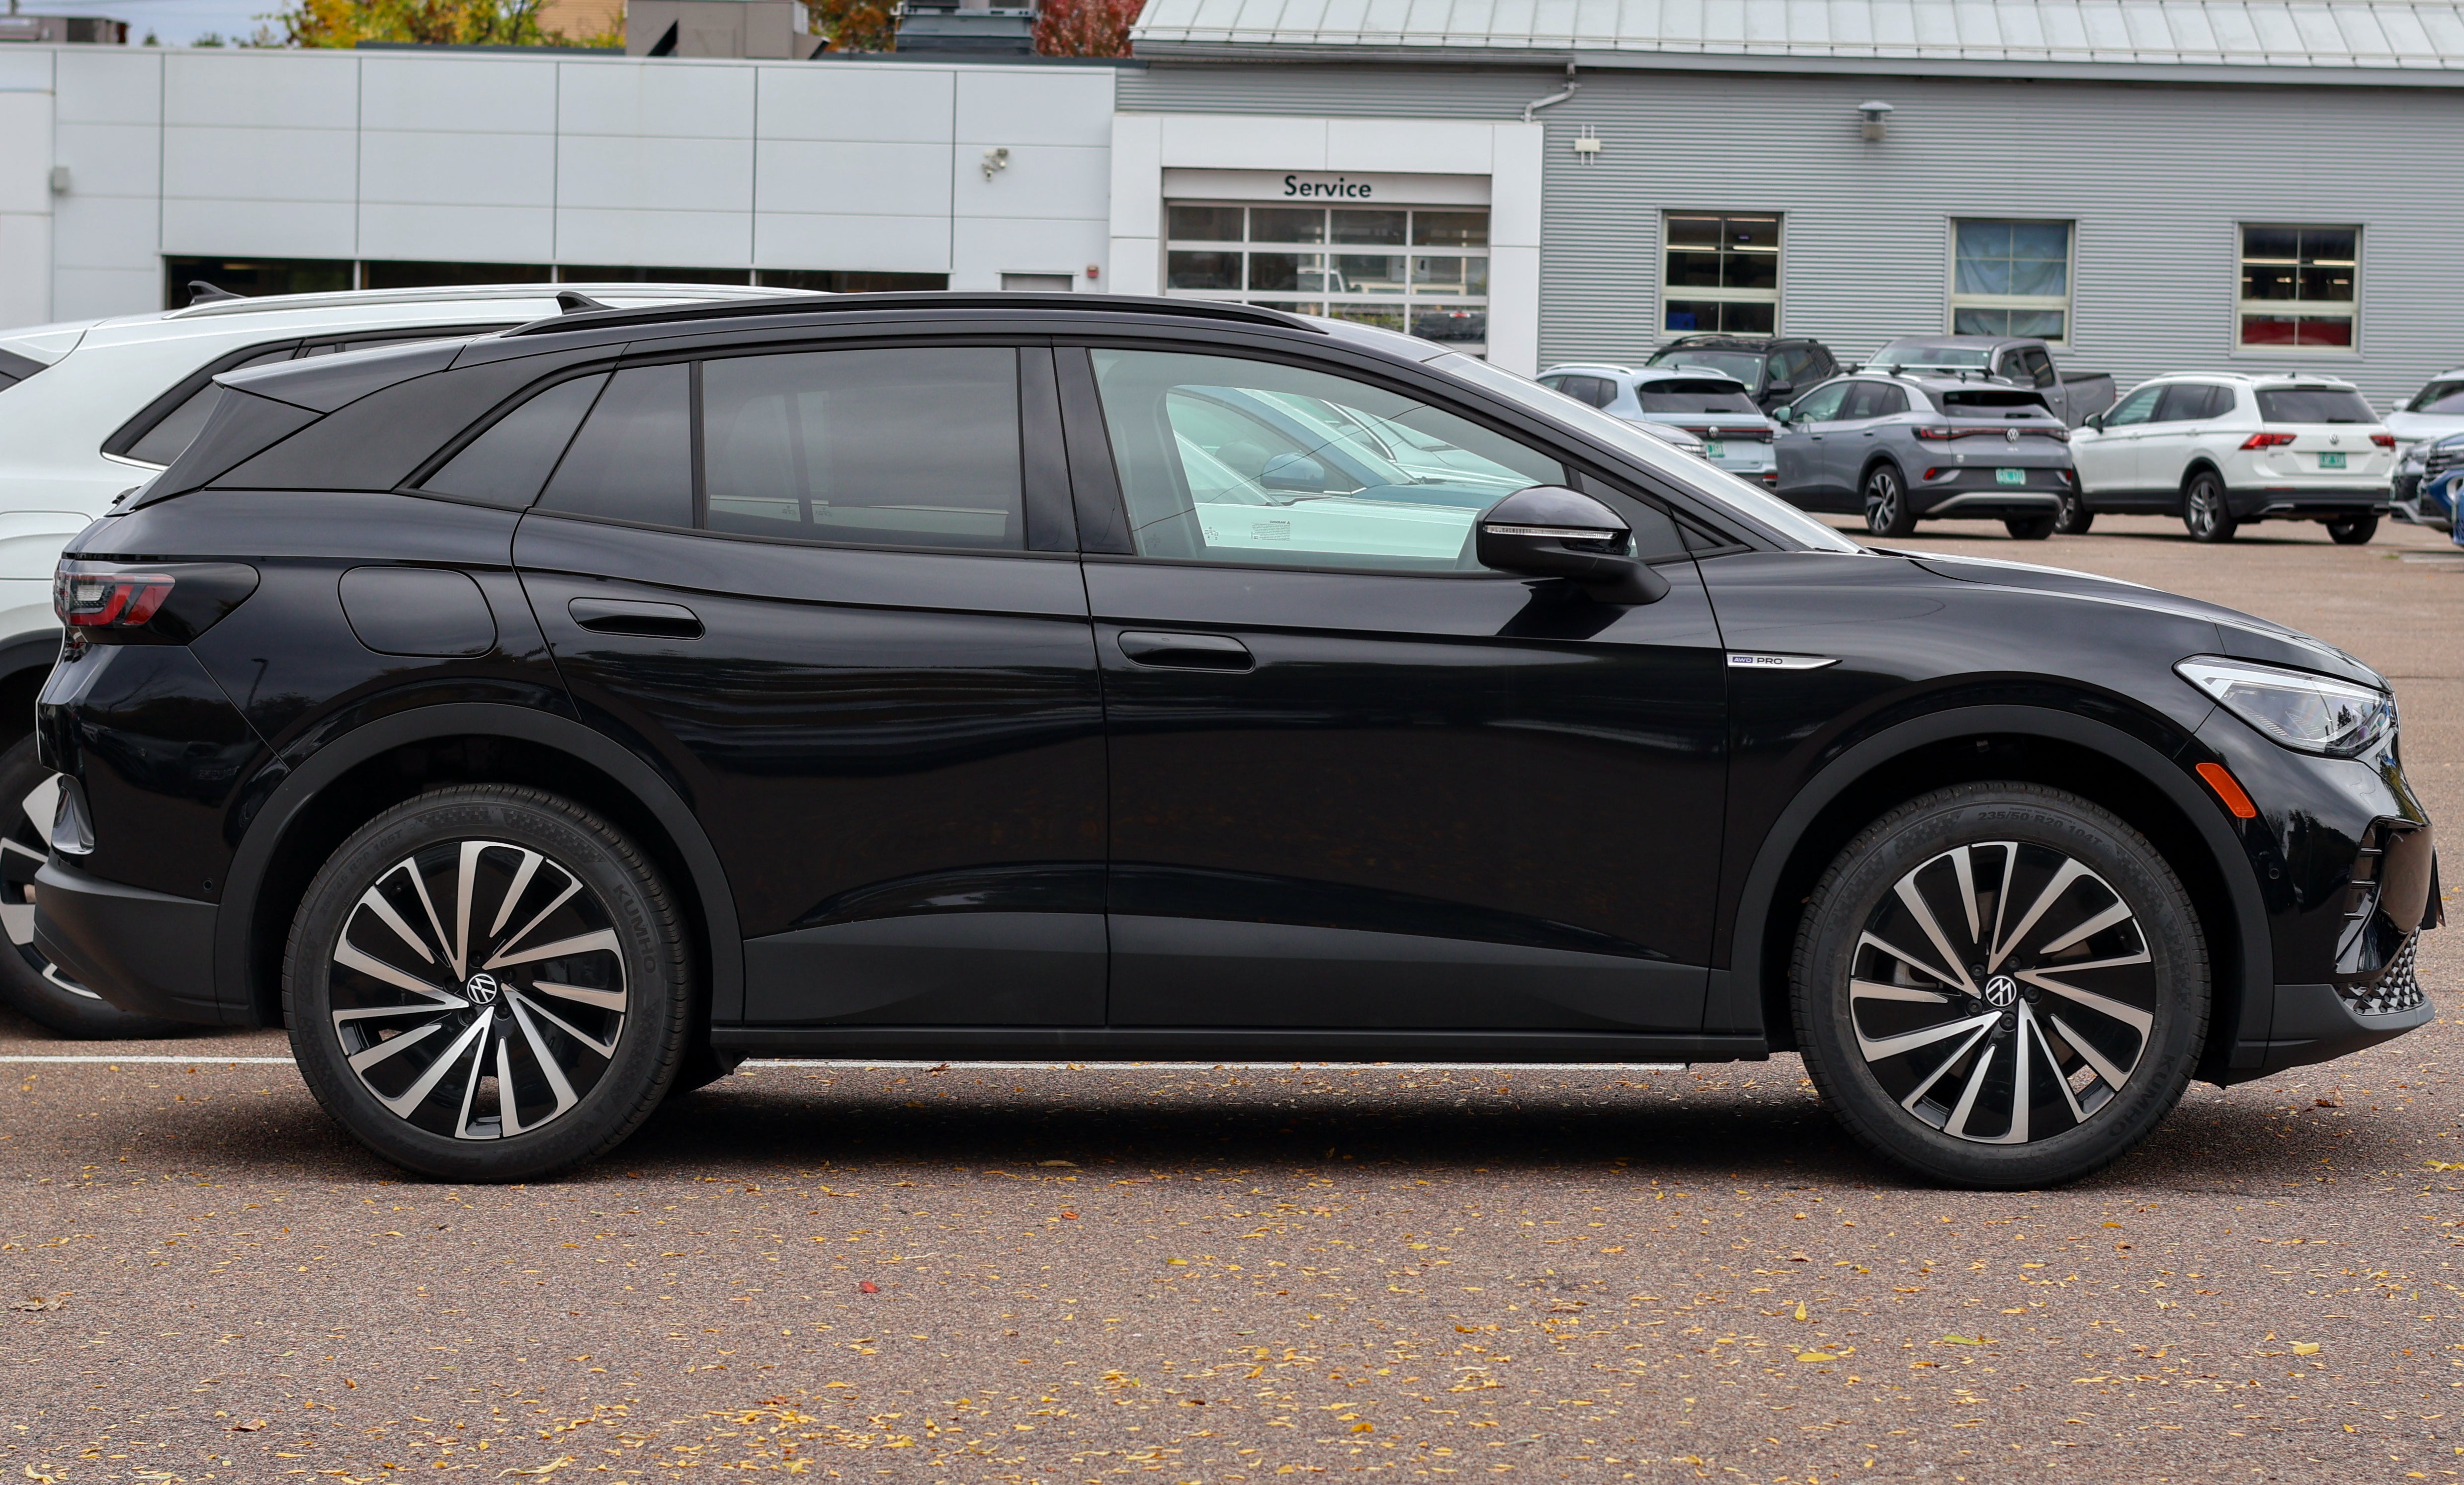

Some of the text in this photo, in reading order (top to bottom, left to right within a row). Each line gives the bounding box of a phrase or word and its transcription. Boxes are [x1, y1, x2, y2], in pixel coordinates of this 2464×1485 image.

[1284, 175, 1372, 198] Service
[373, 829, 402, 852] 105T
[1978, 811, 2029, 821] 235/50
[2034, 814, 2063, 829] R20
[2068, 825, 2103, 845] 104T
[613, 884, 656, 974] KUMHO
[2108, 1054, 2175, 1137] KUMHO
